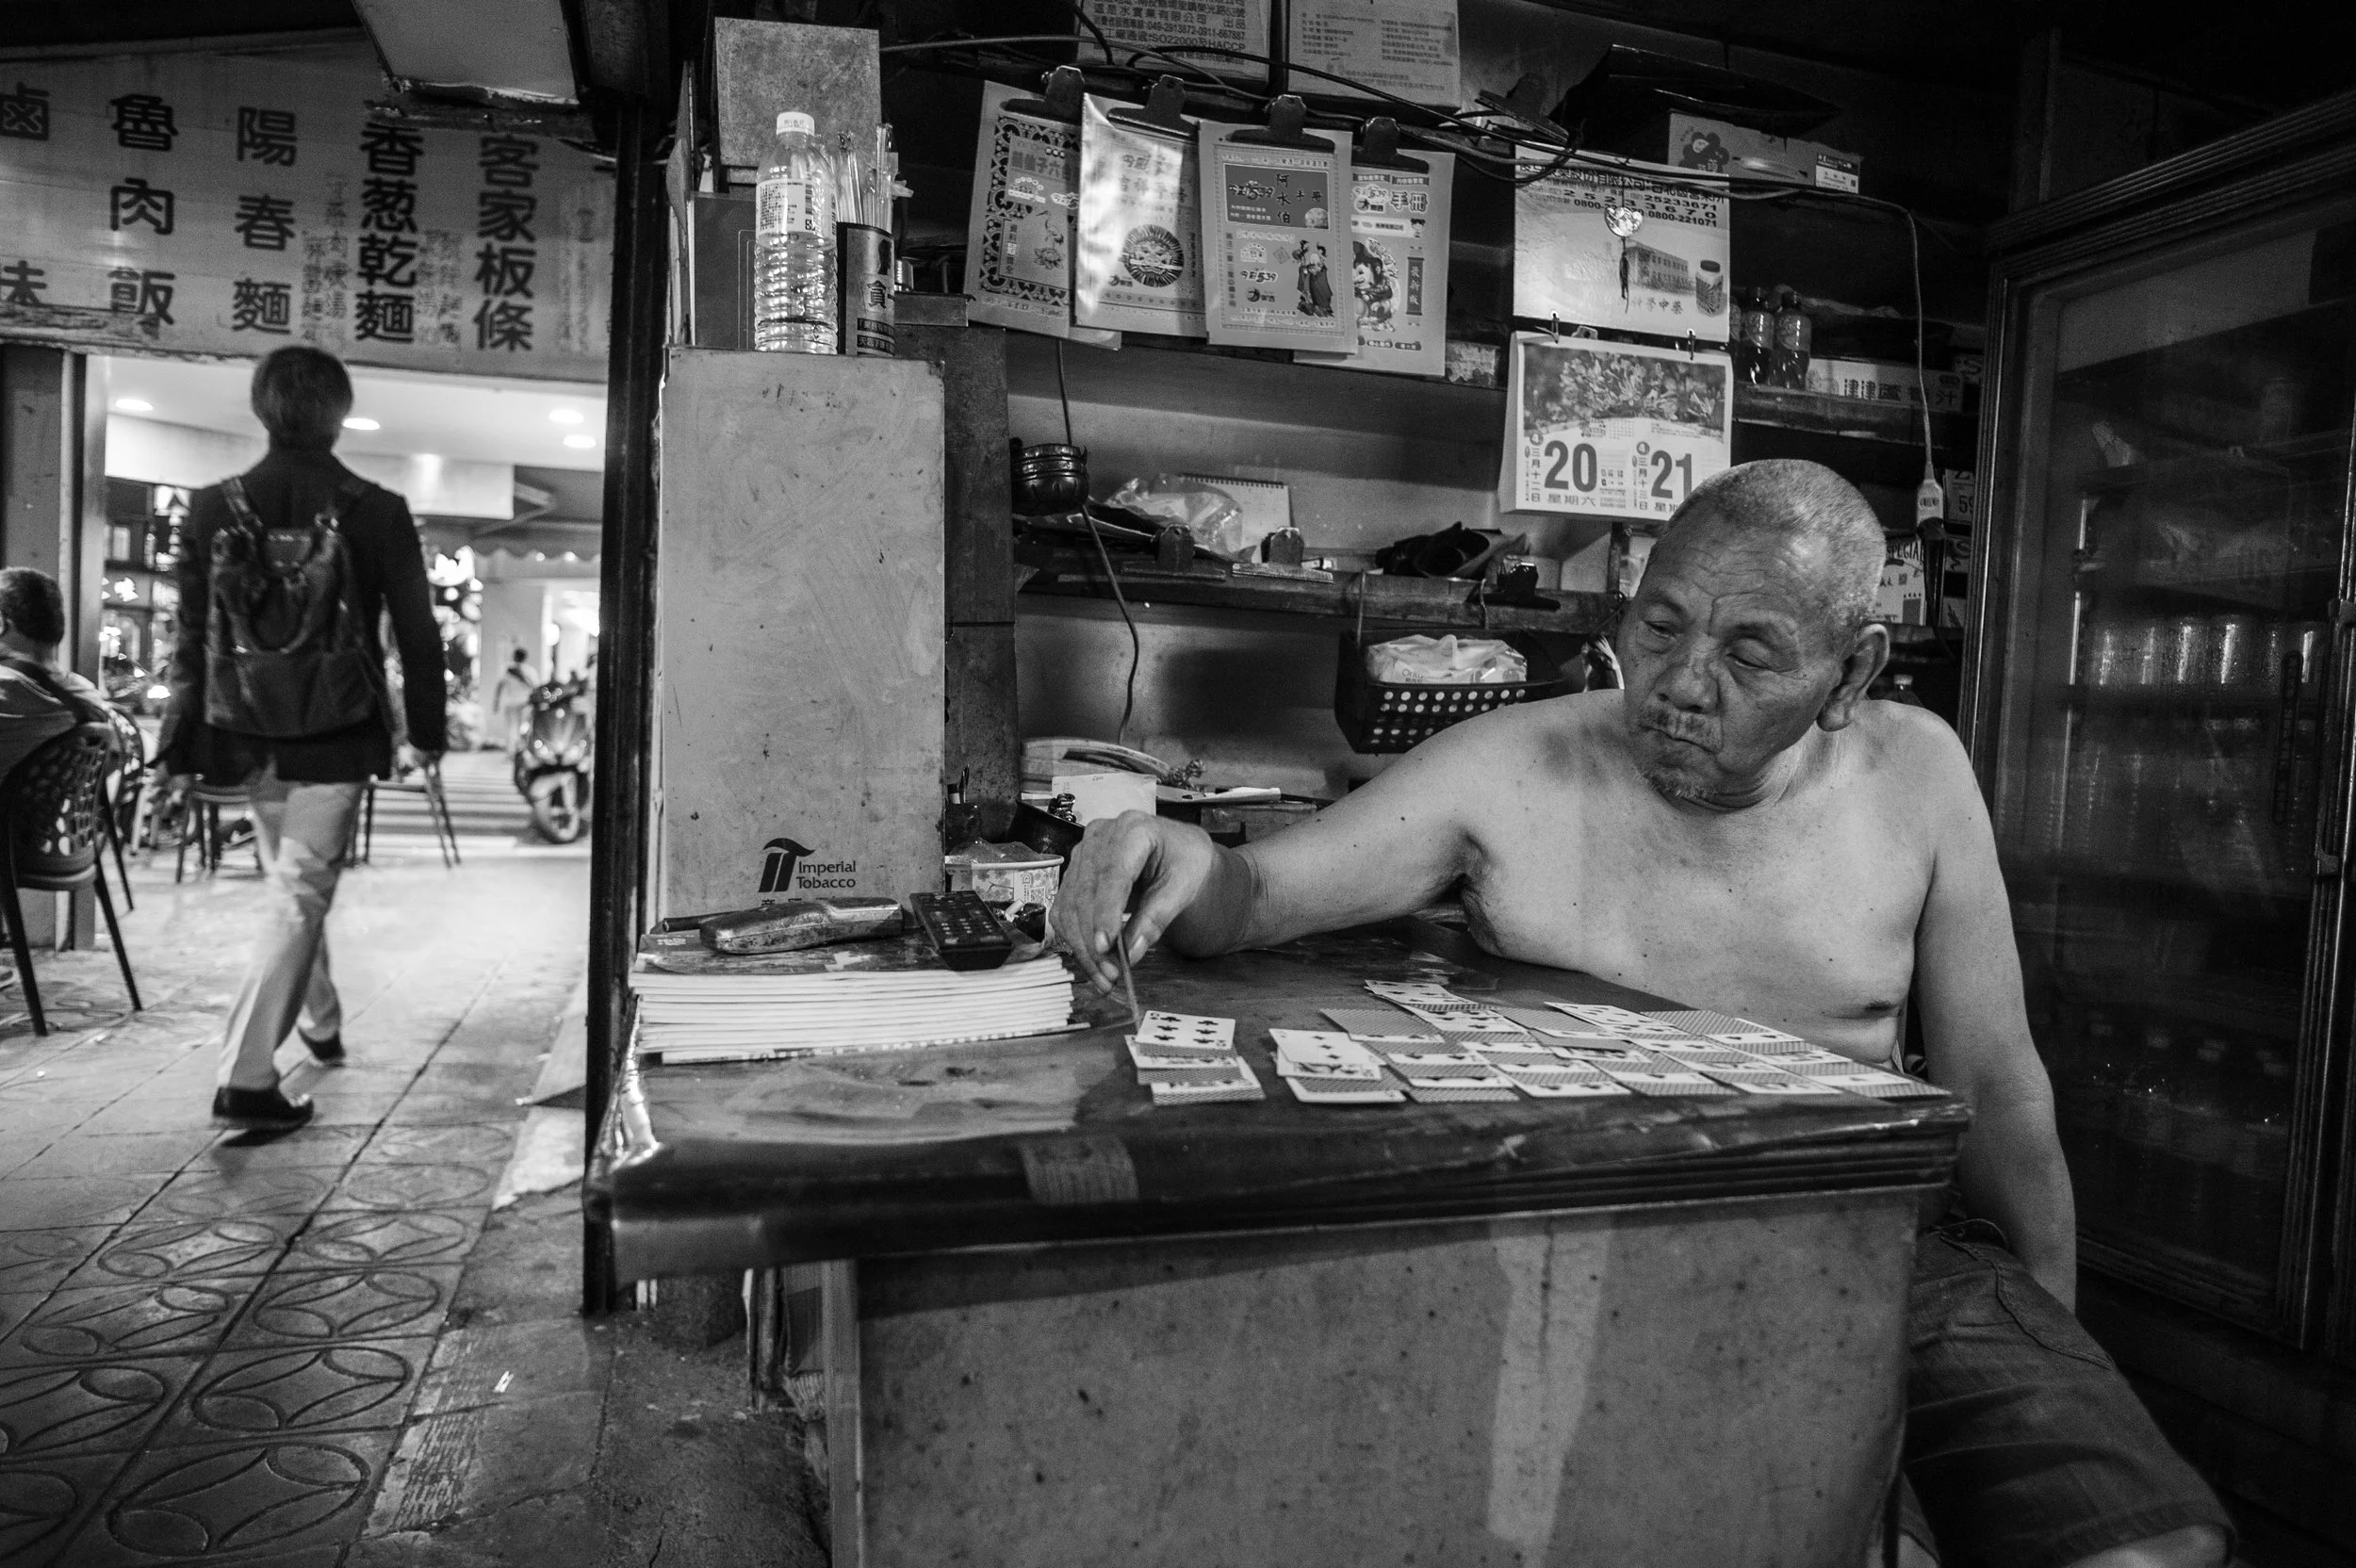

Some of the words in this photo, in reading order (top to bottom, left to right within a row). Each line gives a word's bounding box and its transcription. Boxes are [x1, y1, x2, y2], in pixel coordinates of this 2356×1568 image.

[109, 94, 179, 327] 魯肉飯
[232, 106, 298, 335] 陽春麵
[1644, 195, 1717, 212] 25233671
[1648, 210, 1717, 228] 0800-221071
[473, 134, 540, 353] 客家板條
[1530, 447, 1541, 503] 三月十二日
[1544, 439, 1597, 493] 20
[1638, 457, 1648, 511] 三月十三日
[1650, 449, 1693, 498] 21
[1547, 493, 1596, 507] 星期六
[795, 876, 856, 889] Tobacco
[799, 860, 856, 876] Imperial
